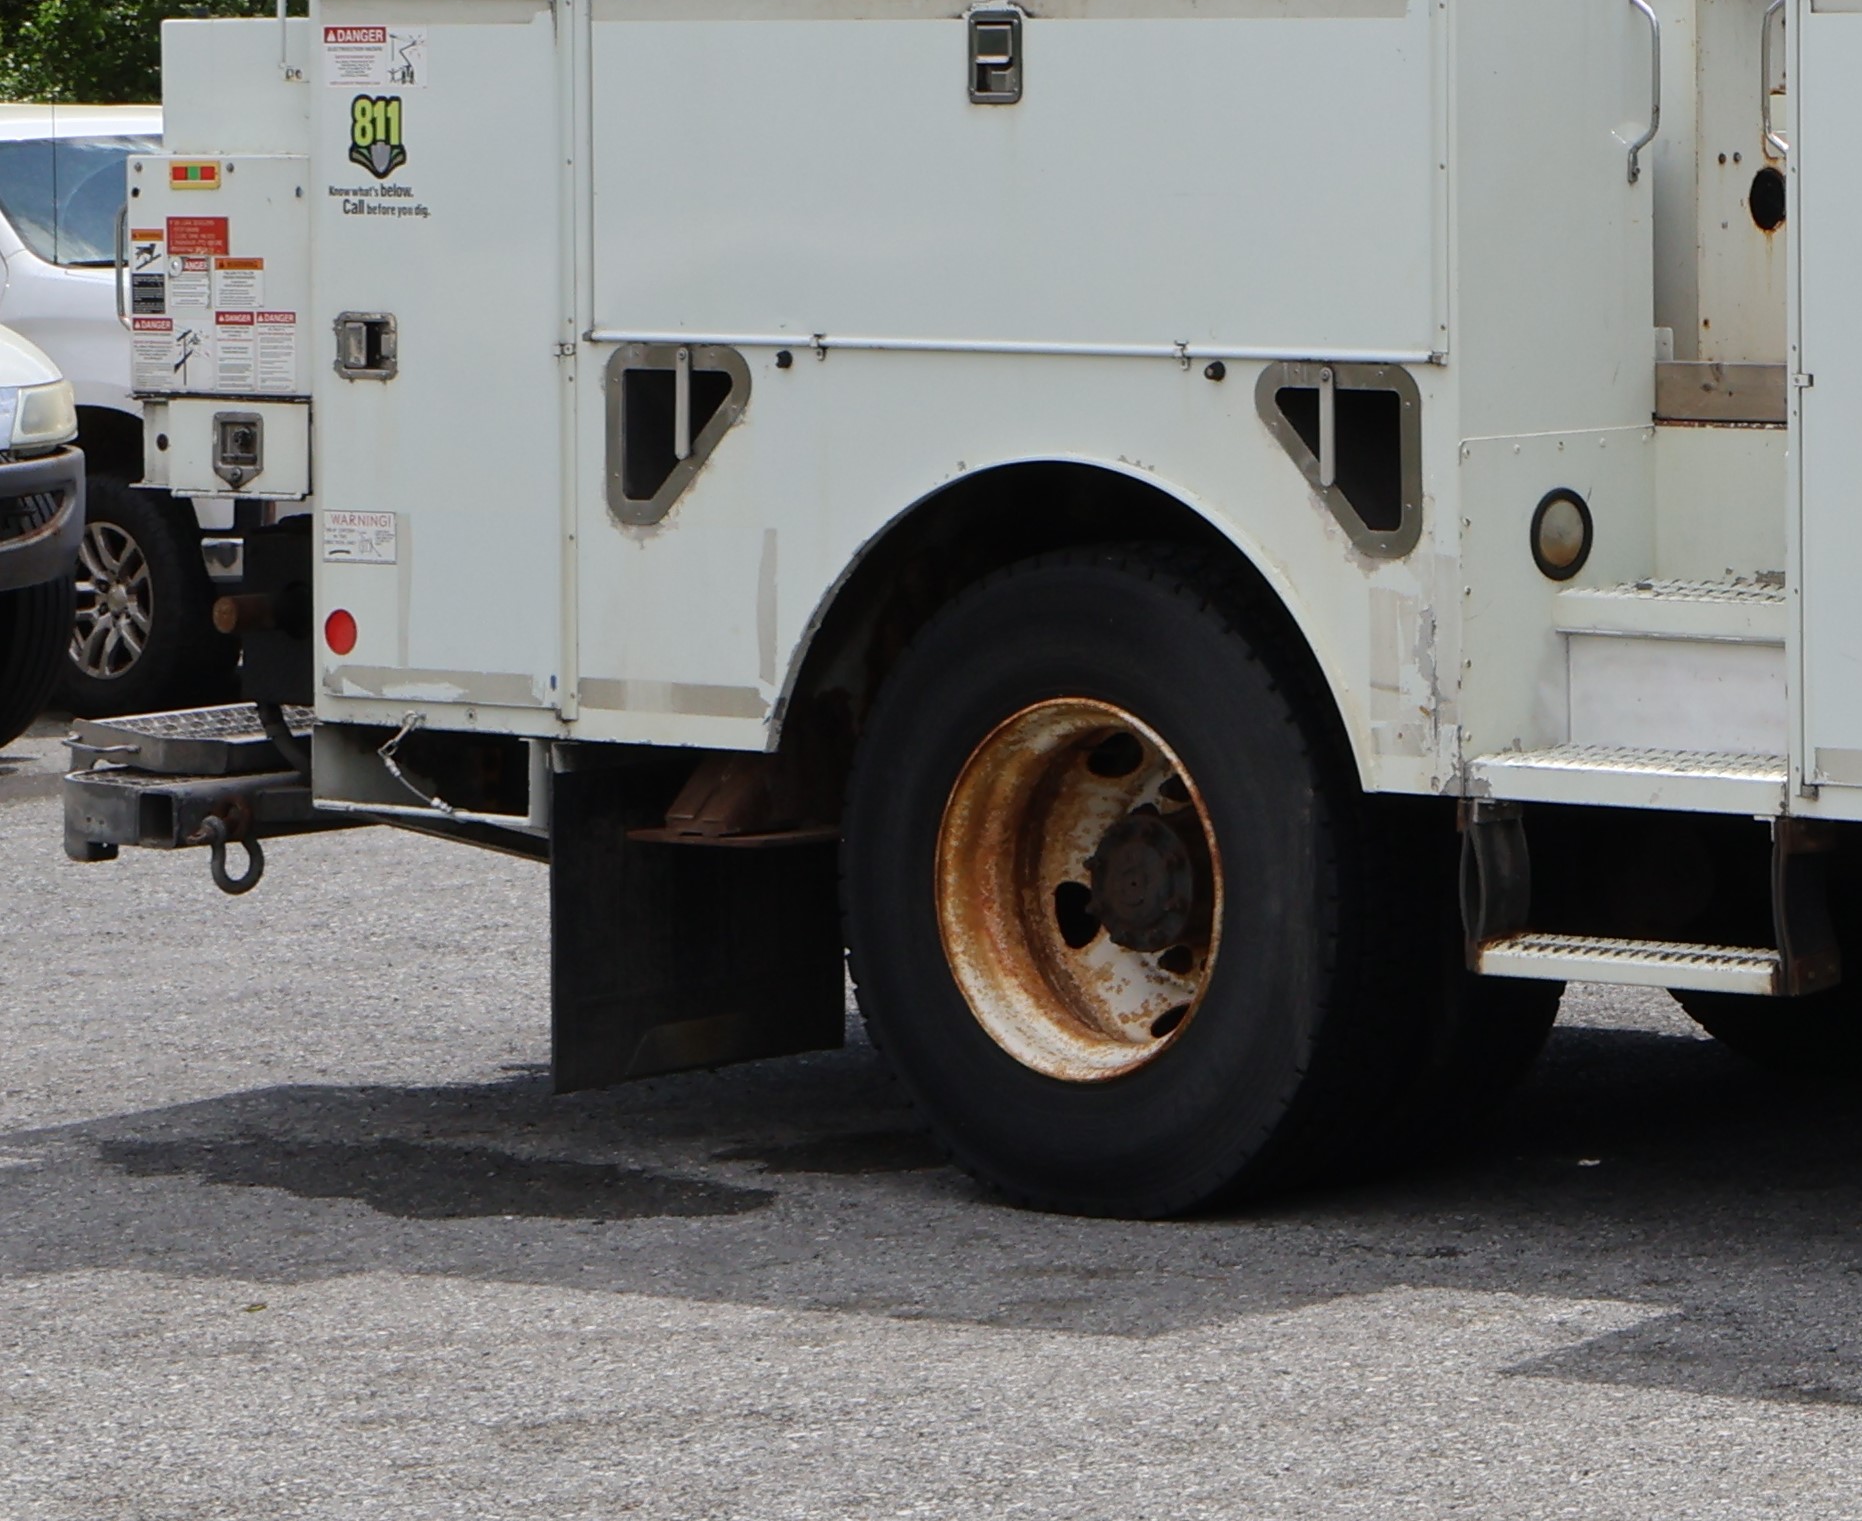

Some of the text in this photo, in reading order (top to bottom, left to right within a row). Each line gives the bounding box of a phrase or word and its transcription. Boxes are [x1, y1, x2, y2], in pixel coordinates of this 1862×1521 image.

[336, 29, 384, 42] DANGER
[352, 96, 401, 147] 811
[328, 183, 414, 198] Know what's below.
[343, 199, 431, 218] Call before you dig.
[225, 314, 251, 322] DANGER
[264, 313, 294, 322] DANGER
[140, 320, 171, 329] DANGER
[331, 514, 391, 527] WARNING!
